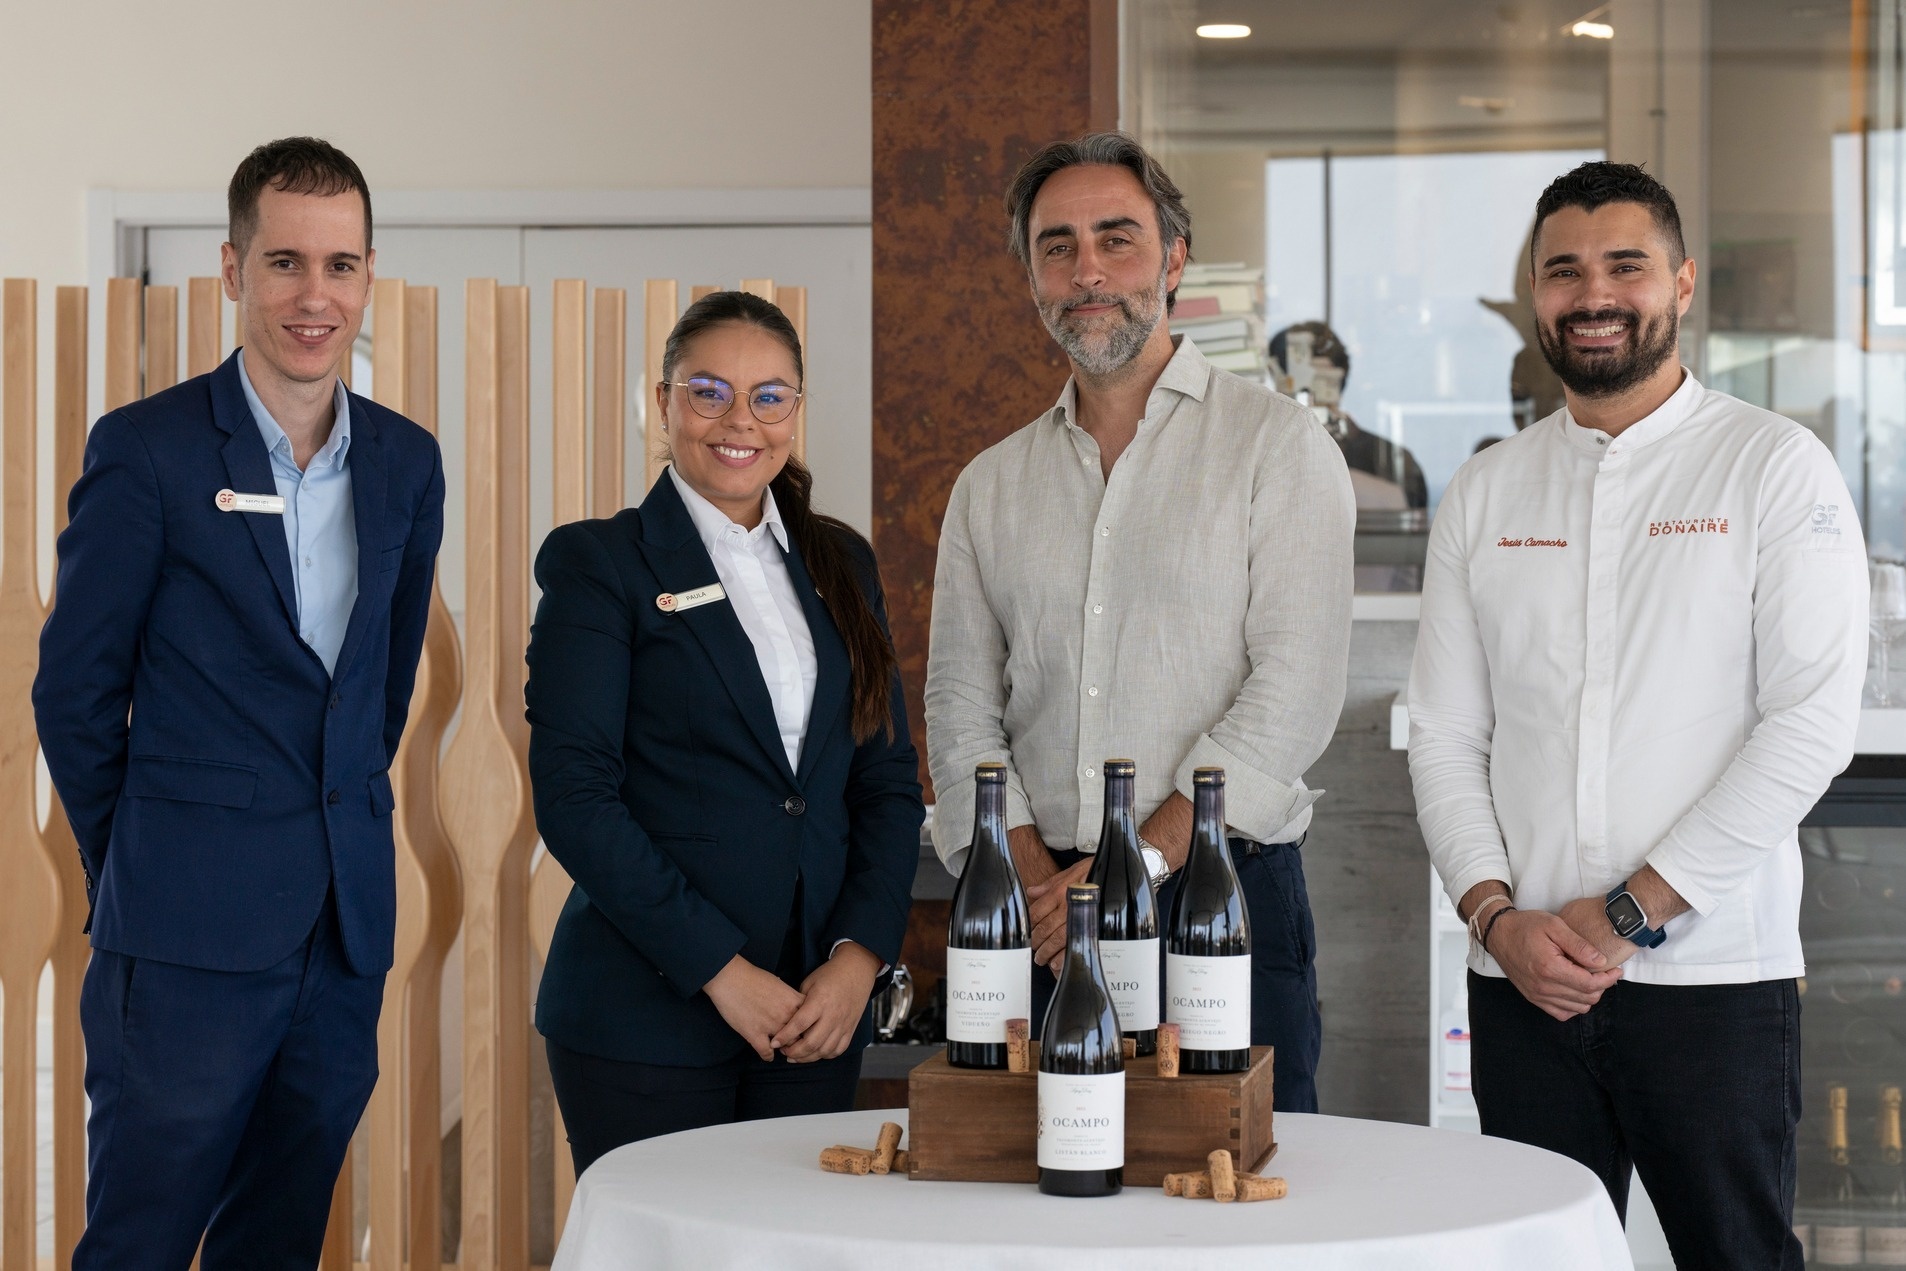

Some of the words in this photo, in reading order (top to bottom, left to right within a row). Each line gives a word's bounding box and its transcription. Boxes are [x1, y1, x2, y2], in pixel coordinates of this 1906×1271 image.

[219, 493, 234, 503] GF
[1811, 504, 1839, 526] GF
[1650, 517, 1729, 527] RESTAURANTE
[1649, 523, 1729, 537] DONAIRE
[1524, 536, 1568, 548] Camacho
[659, 595, 673, 606] GF
[686, 592, 706, 601] PAULA
[1110, 981, 1139, 991] MPO
[952, 990, 1005, 1001] OCAMPO
[1173, 997, 1226, 1008] OCAMPO
[1052, 1117, 1110, 1128] OCAMPO
